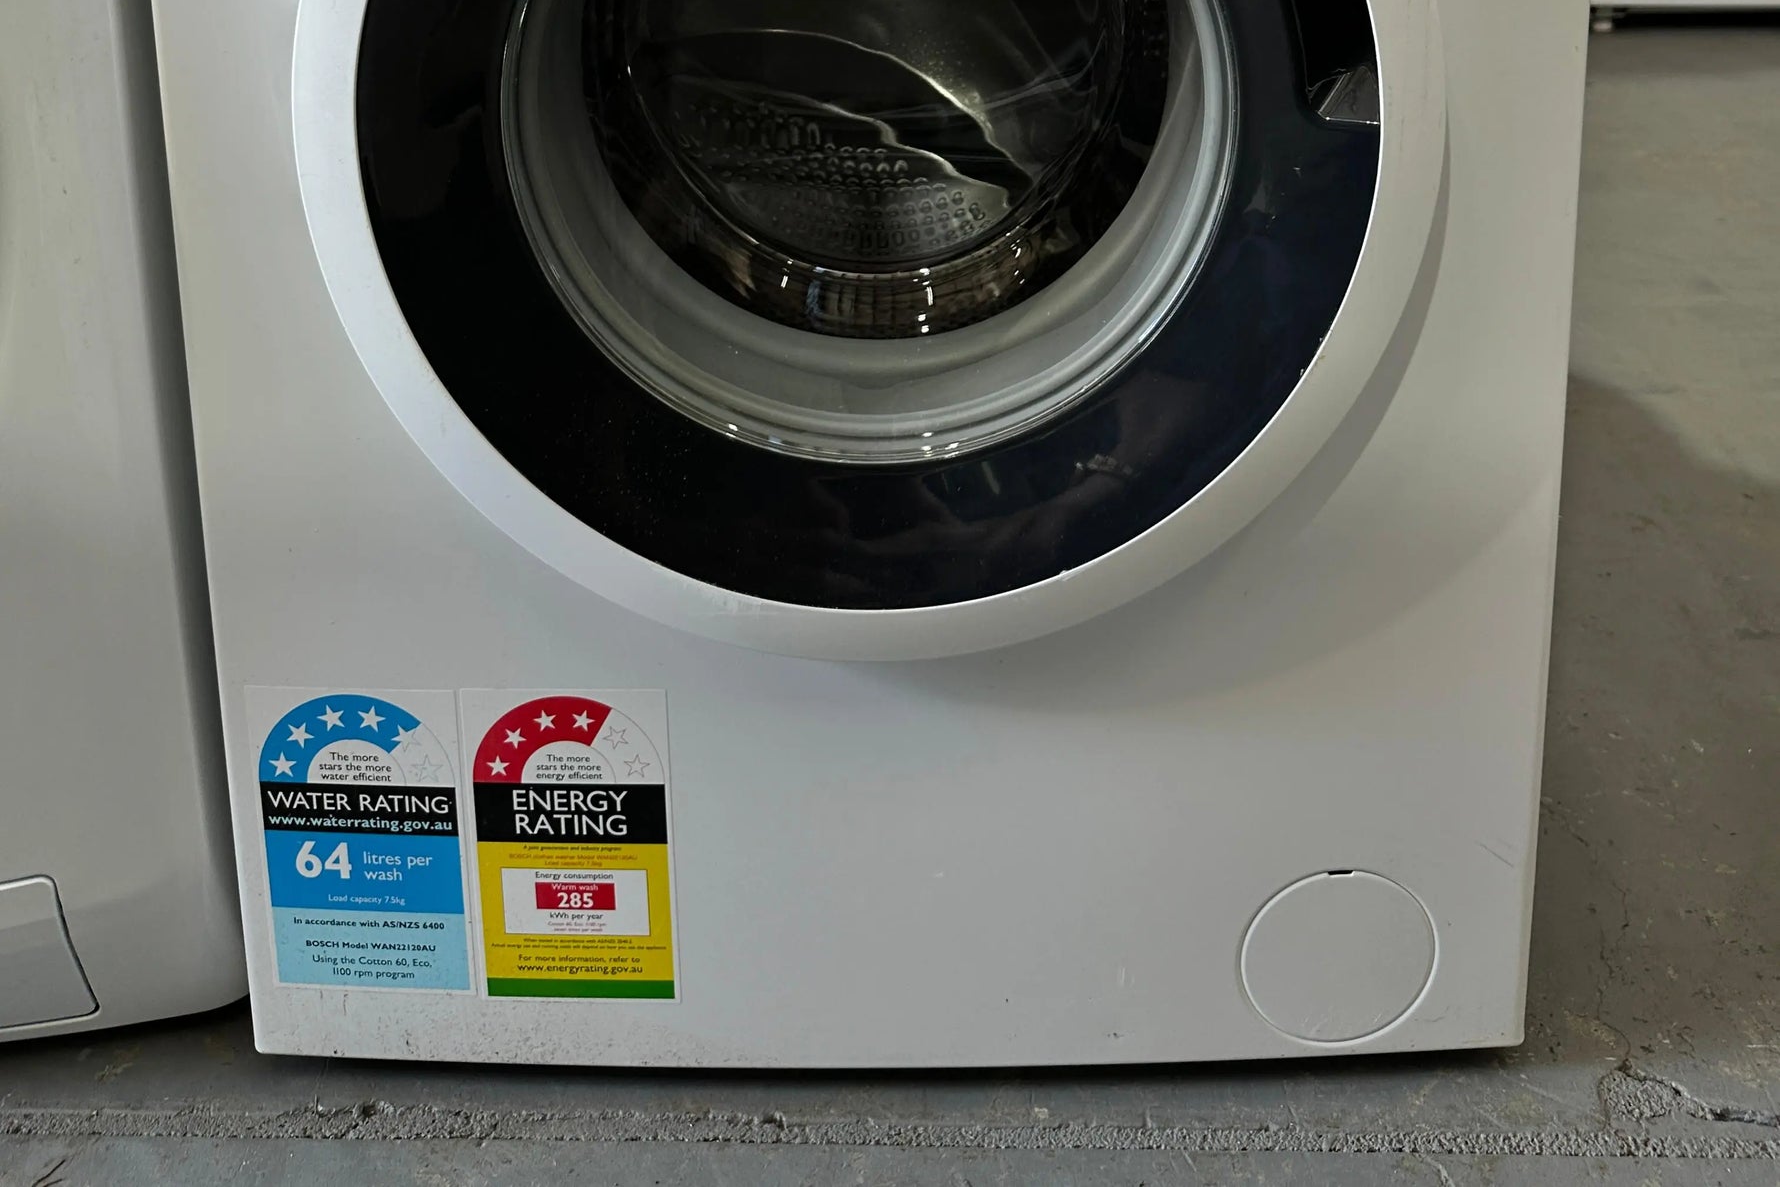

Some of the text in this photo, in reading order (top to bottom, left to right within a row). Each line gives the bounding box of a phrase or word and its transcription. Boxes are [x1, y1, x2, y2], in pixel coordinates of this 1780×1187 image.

[329, 751, 379, 762] The more
[546, 754, 565, 763] The
[319, 762, 392, 773] stars the more
[536, 763, 557, 771] stars
[560, 763, 576, 771] the
[321, 772, 392, 782] water efficient
[536, 772, 603, 781] energy efficient
[267, 790, 450, 814] WATER RATING
[512, 789, 628, 812] ENERGY
[268, 815, 453, 832] www.waterrating.gov.au
[514, 813, 628, 836] RATING
[295, 840, 353, 880] 64
[363, 851, 433, 871] litres per
[364, 868, 403, 881] wash
[535, 871, 614, 880] Energy consumption
[551, 883, 577, 891] Warm
[328, 893, 348, 902] Load
[350, 895, 382, 905] capacity
[557, 892, 594, 908] 285
[293, 916, 445, 930] In accordance with AS/NZS 6400
[571, 914, 584, 922] per
[305, 939, 436, 952] BOSCH Model WAN22120AU
[312, 954, 338, 965] Using
[340, 955, 356, 965] the
[358, 956, 393, 966] Cotton
[518, 954, 532, 962] For
[535, 955, 556, 963] more
[558, 954, 606, 964] information,
[608, 955, 629, 963] refer
[332, 967, 415, 980] 1100 rpm program
[517, 964, 643, 975] www.energyrating.gov.au
